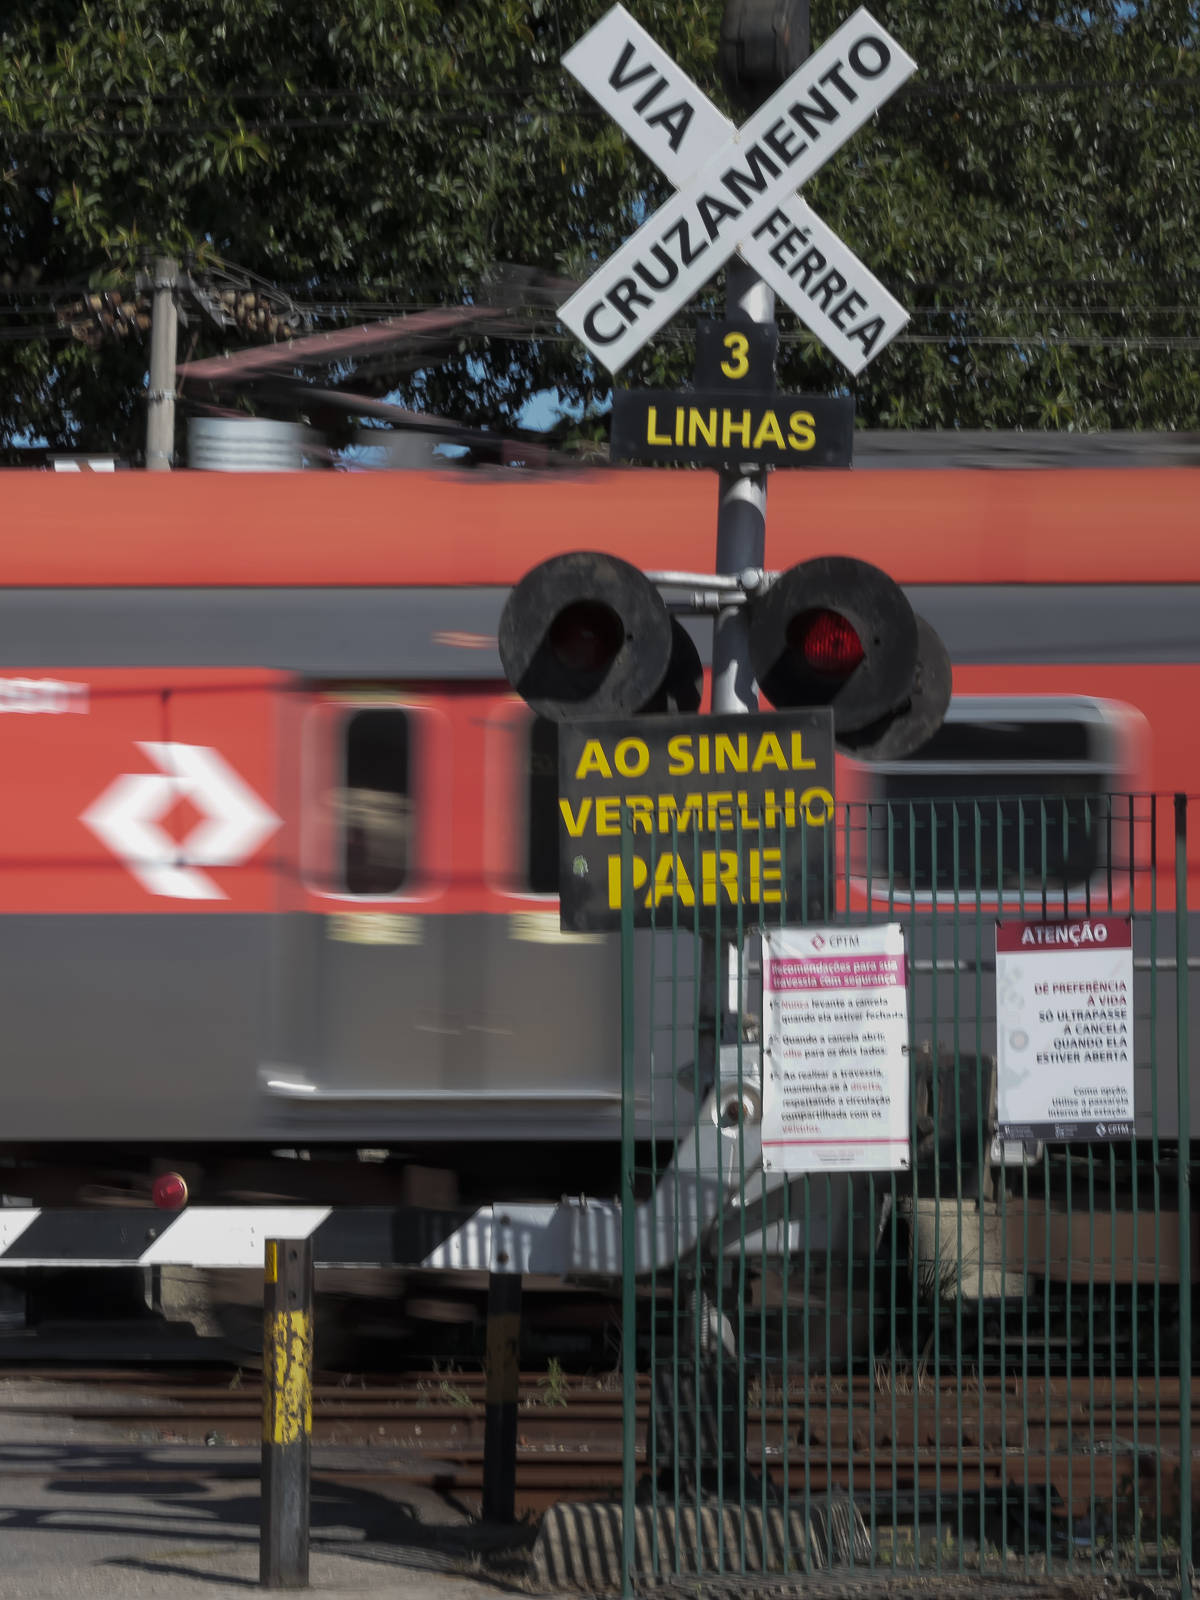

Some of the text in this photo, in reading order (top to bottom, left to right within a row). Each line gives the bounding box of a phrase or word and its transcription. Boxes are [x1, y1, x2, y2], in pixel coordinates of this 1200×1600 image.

[608, 40, 696, 154] VIA
[582, 35, 892, 346] CRUZAMENTO
[752, 208, 887, 359] FÉRREA
[720, 332, 749, 379] 3
[647, 406, 817, 451] LINHAS
[575, 730, 816, 779] AO SINAL
[558, 786, 834, 837] VERMELHO
[607, 848, 787, 909] PARE
[829, 935, 860, 948] CPTM
[1021, 921, 1108, 947] ATENÇÃO
[853, 962, 877, 974] para
[819, 976, 841, 986] com
[844, 974, 897, 987] segurança
[1052, 980, 1127, 993] PREFERÊNCIA
[1099, 995, 1127, 1006] VIDA
[1057, 1008, 1127, 1022] ULTRAPASSE
[1064, 1023, 1127, 1035] A CANCELA
[1053, 1036, 1127, 1050] QUANDO ELA
[1036, 1050, 1128, 1064] ESTIVER ABERTA
